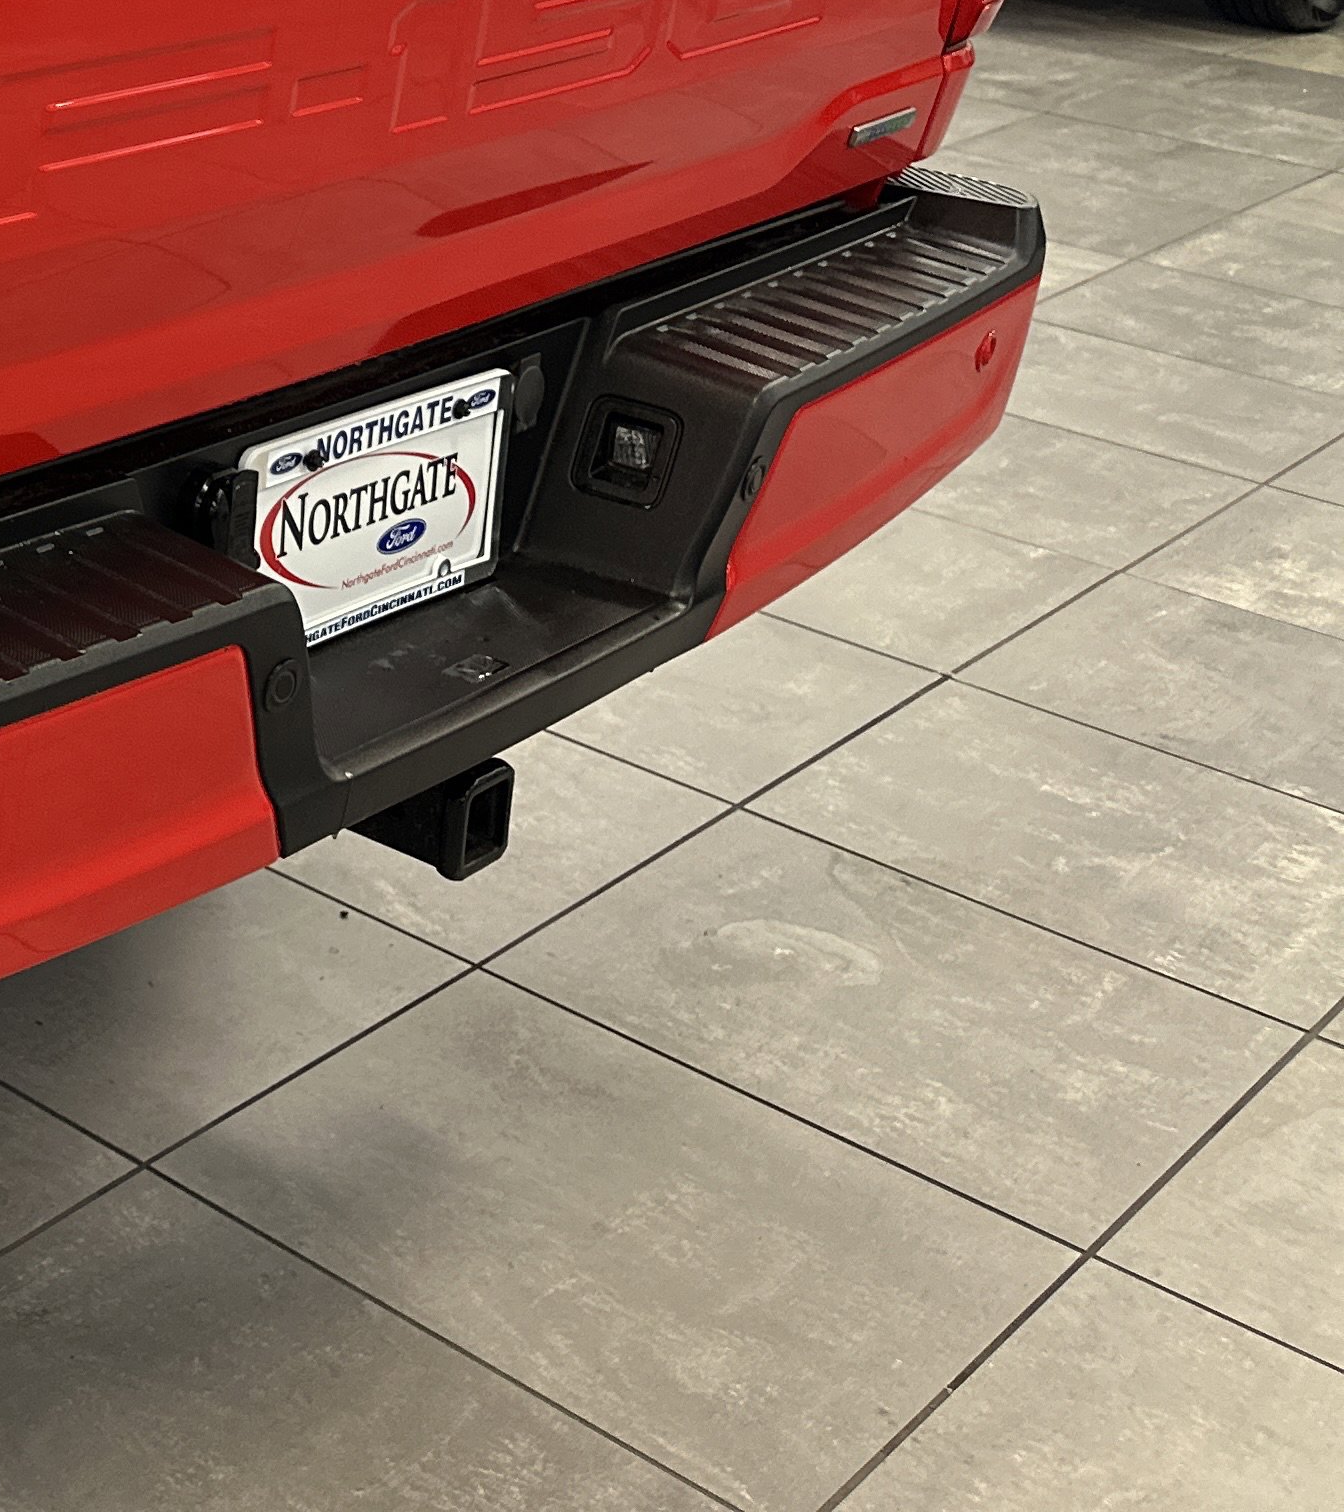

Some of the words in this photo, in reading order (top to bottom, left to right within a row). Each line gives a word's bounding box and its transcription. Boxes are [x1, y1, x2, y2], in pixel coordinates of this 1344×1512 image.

[316, 395, 454, 463] NORTHGATE
[276, 452, 459, 560] NORTHGATE
[385, 523, 418, 551] Ford
